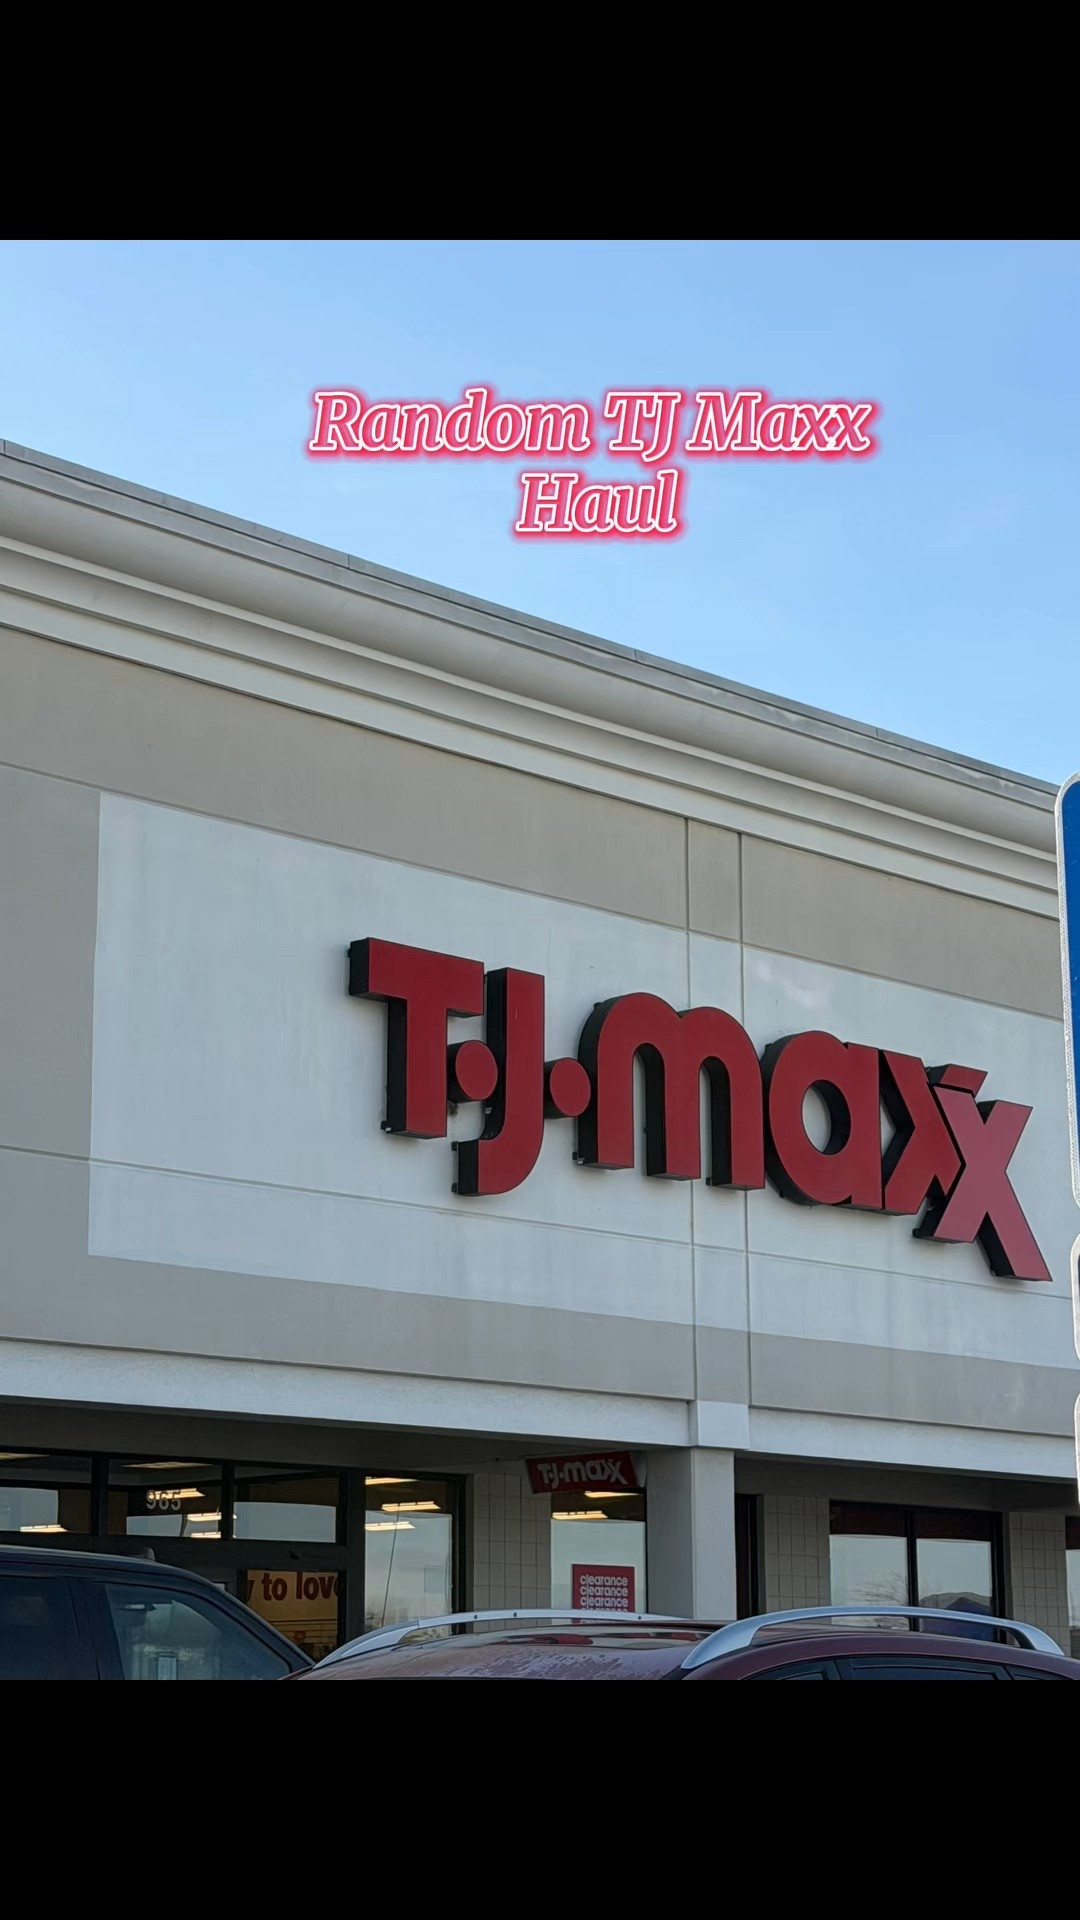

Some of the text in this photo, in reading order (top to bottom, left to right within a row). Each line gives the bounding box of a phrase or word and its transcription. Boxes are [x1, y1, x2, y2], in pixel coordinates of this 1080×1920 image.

[146, 1489, 182, 1510] 965
[261, 1572, 288, 1601] to
[296, 1571, 339, 1600] lov
[580, 1574, 629, 1586] clearance
[580, 1585, 629, 1597] clearance
[580, 1595, 629, 1607] clearance
